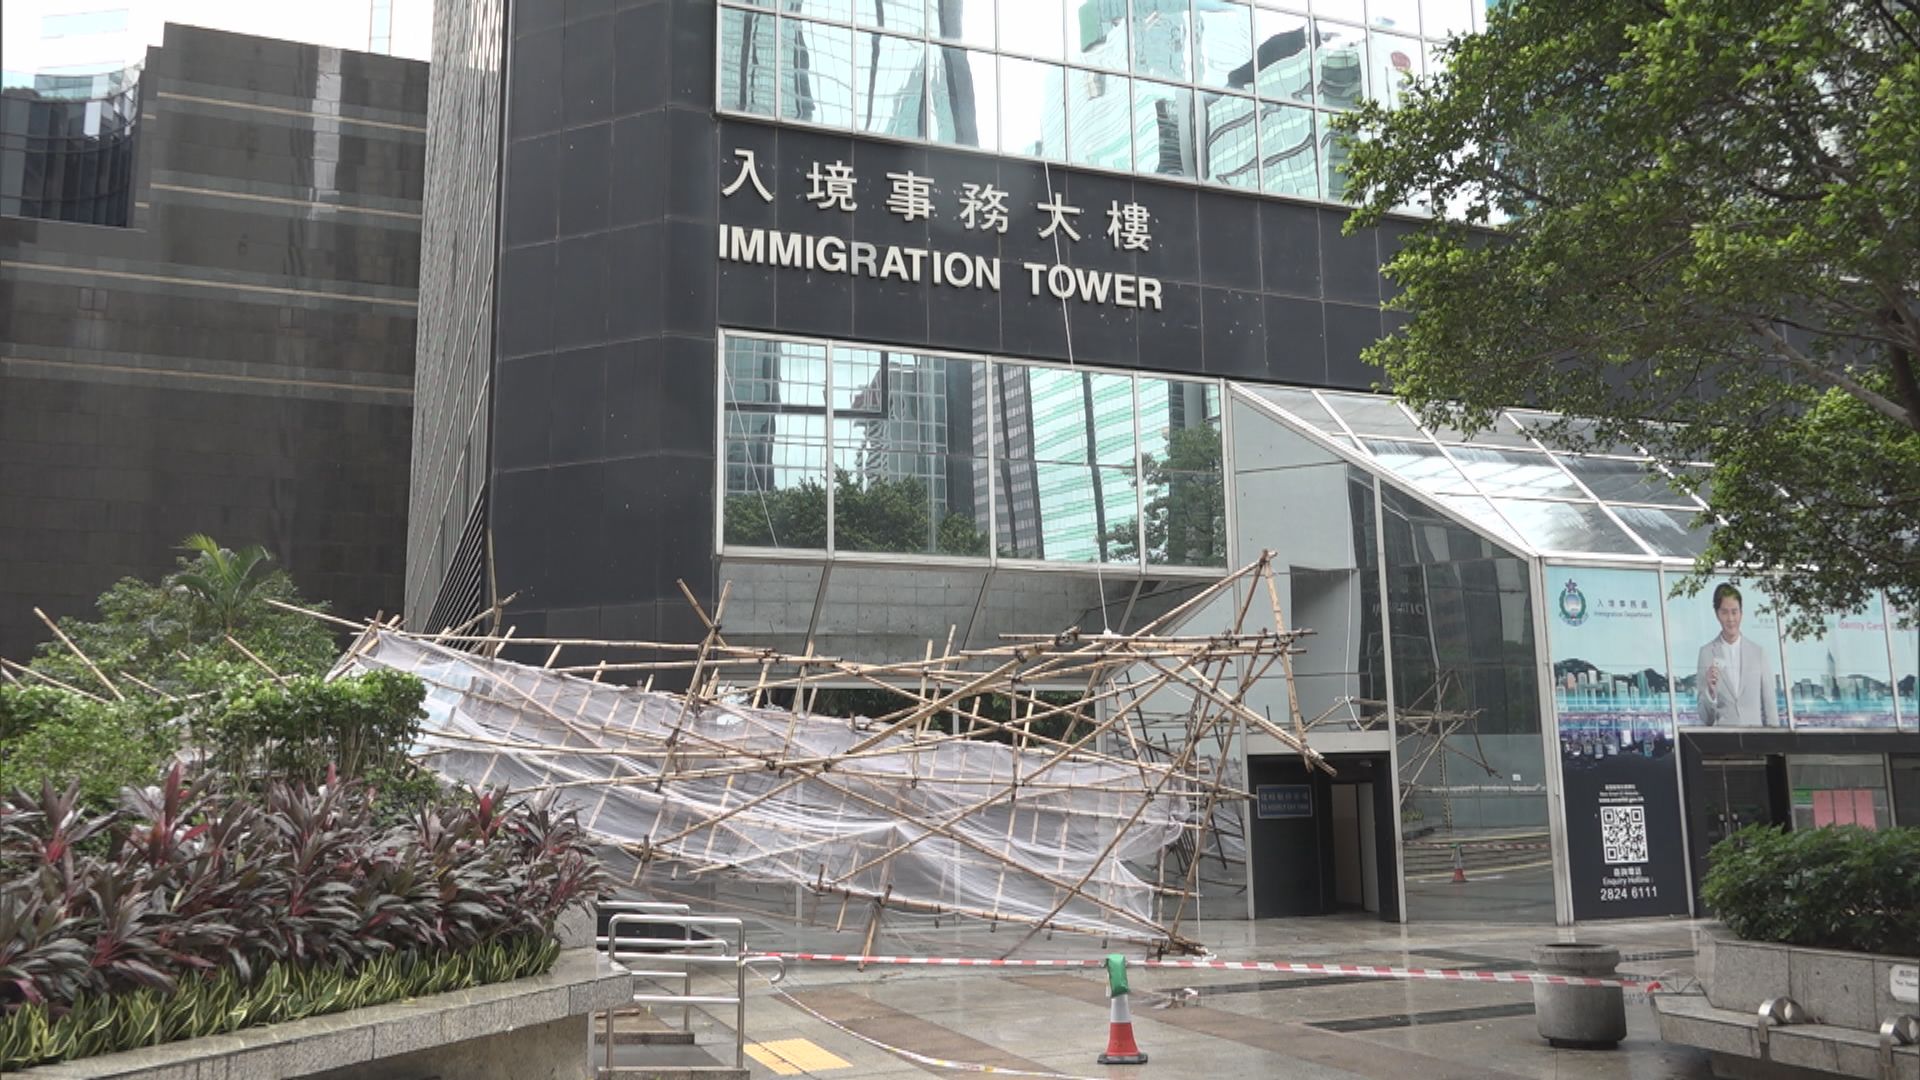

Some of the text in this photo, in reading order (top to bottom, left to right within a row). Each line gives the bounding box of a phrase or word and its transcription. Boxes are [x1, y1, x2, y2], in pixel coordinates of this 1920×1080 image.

[721, 148, 1151, 252] 入境事務大樓
[718, 223, 1163, 311] IMMIGRATION TOWER
[1600, 886, 1658, 901] 2824 6111
